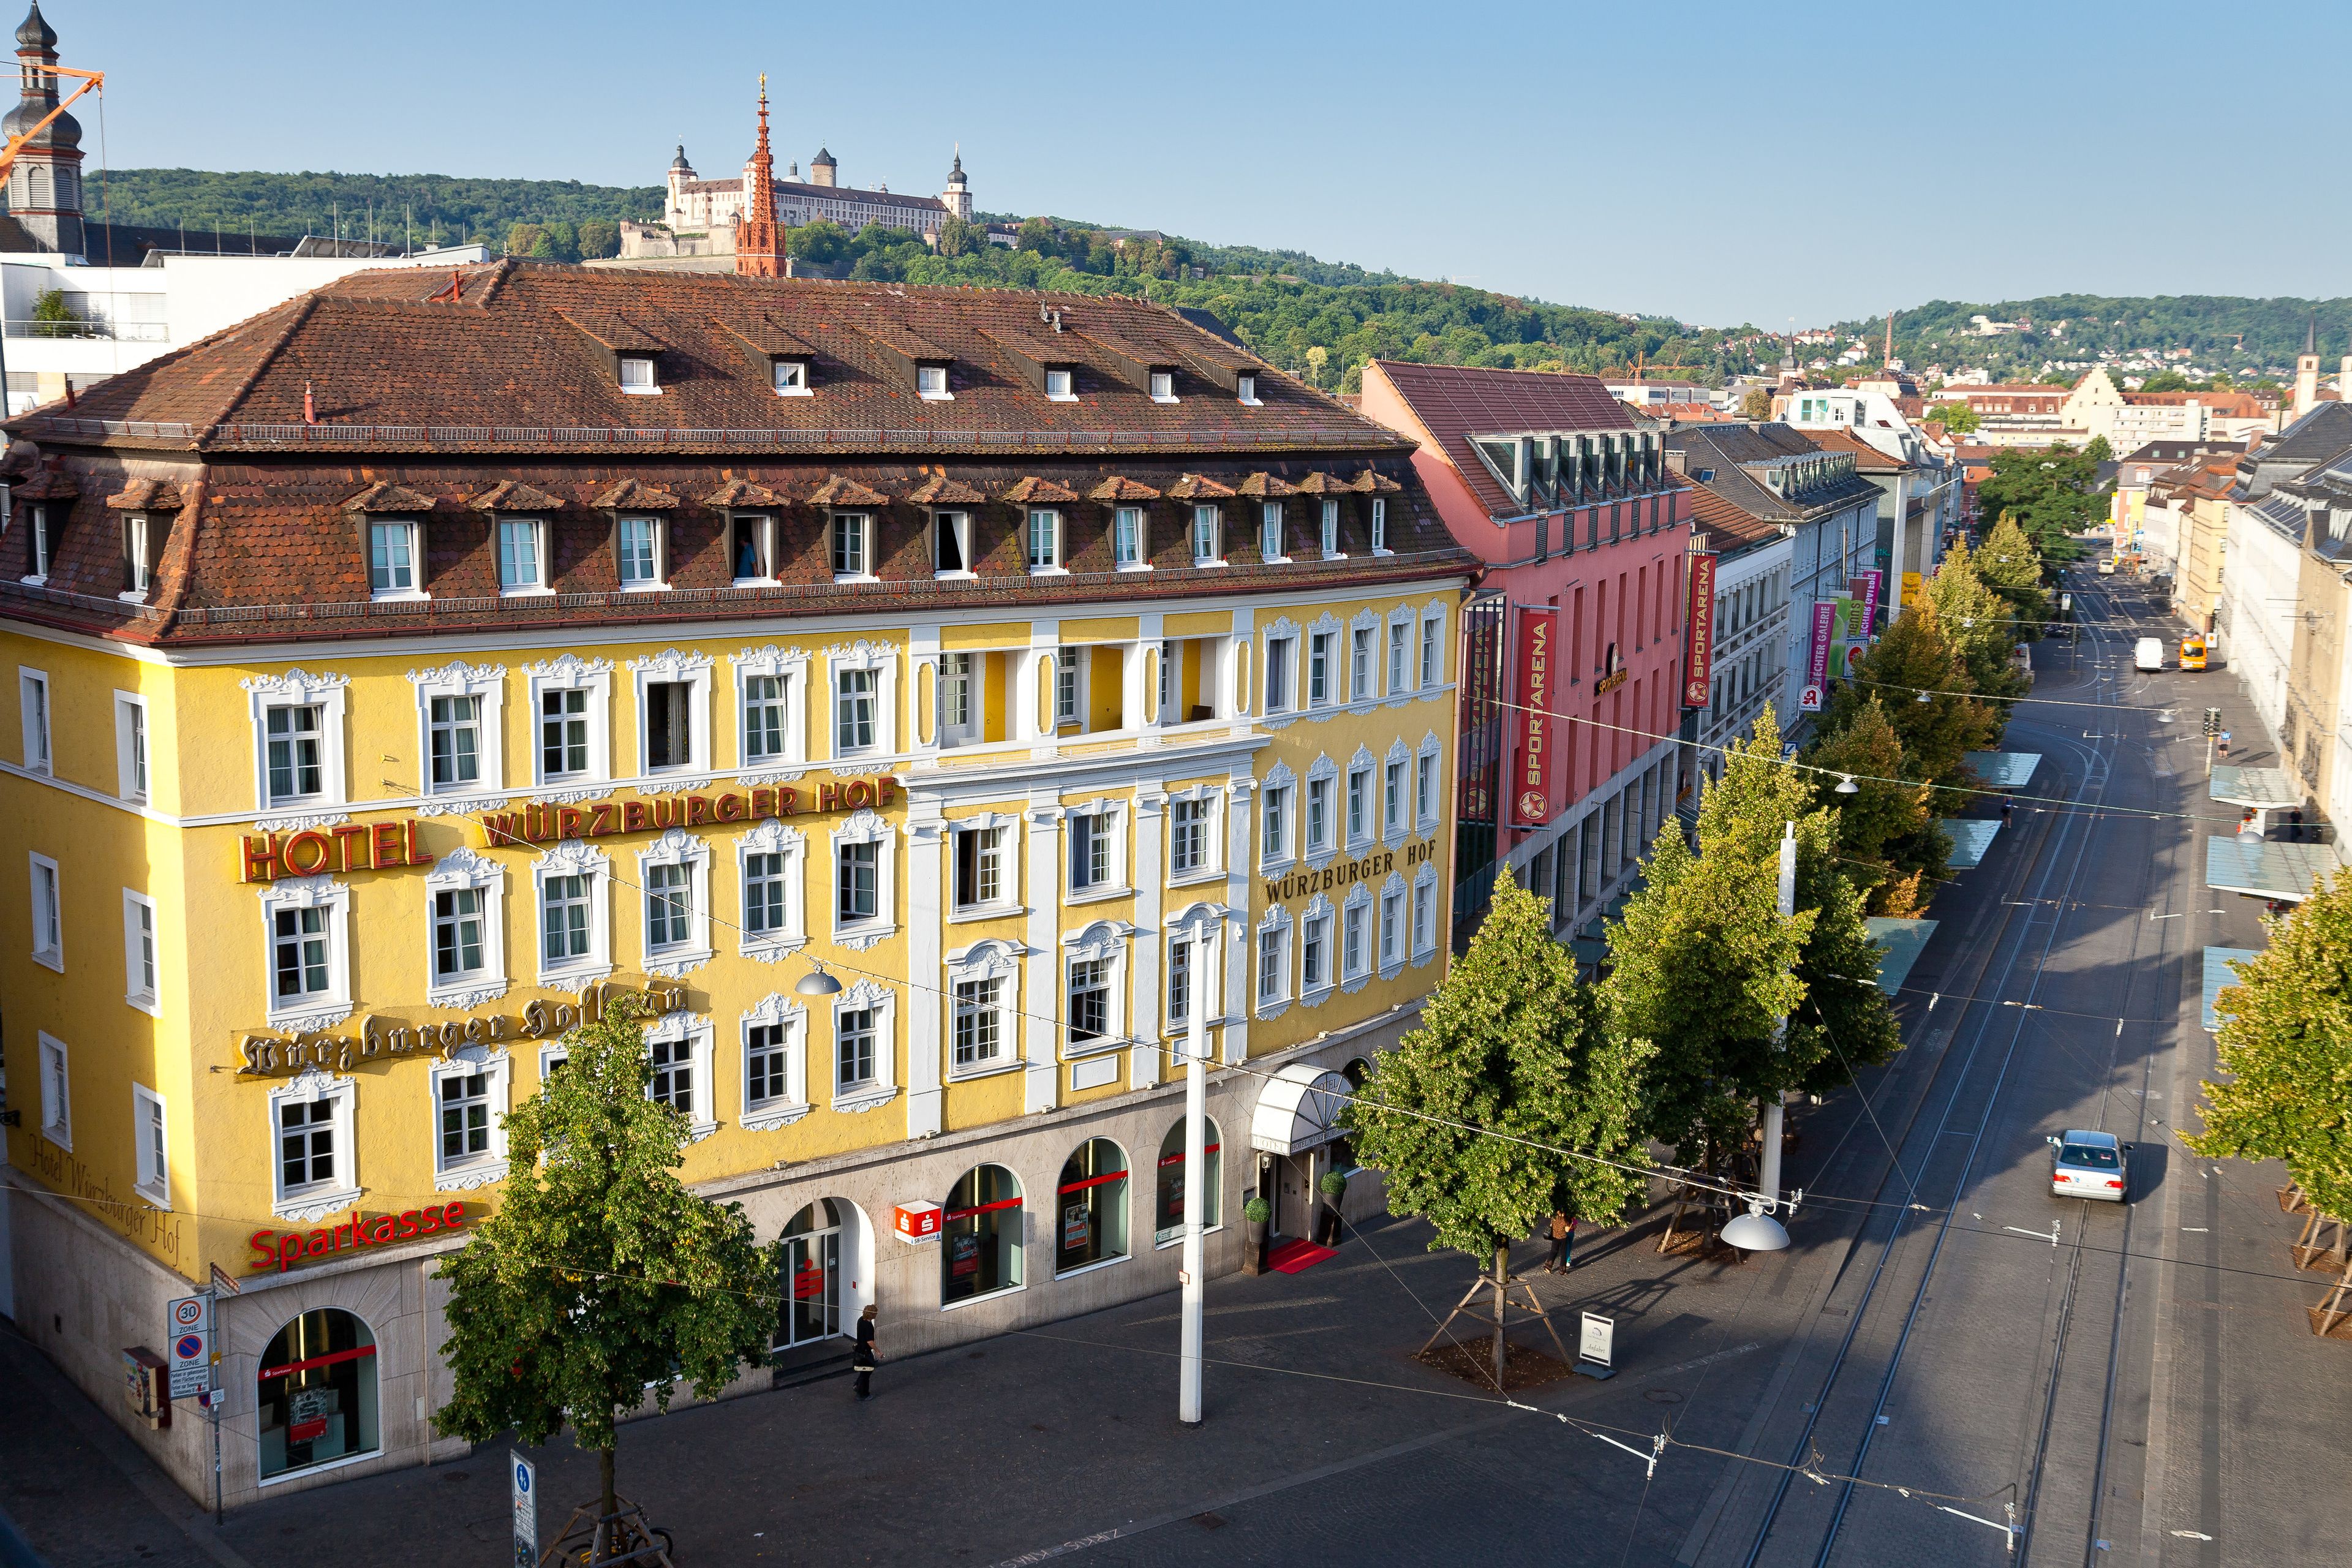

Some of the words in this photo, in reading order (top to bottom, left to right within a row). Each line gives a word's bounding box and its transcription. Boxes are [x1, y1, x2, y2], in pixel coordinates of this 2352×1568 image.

[1694, 560, 1710, 677] SPORTARENA
[1817, 606, 1830, 642] GALERIE
[1813, 644, 1826, 677] ECHTER
[1599, 668, 1627, 696] SPORTARENA
[1528, 622, 1547, 786] SPORTARENA
[480, 786, 796, 847] WÜRZBURGER
[816, 777, 895, 813] HOF
[238, 818, 434, 883] HOTEL
[1265, 852, 1393, 904] WÜRZBURGER
[1407, 839, 1437, 866] HOF
[236, 1014, 507, 1074] Würzburger
[1313, 1078, 1338, 1095] HOTEL
[1292, 1140, 1308, 1152] HOTEL
[29, 1133, 62, 1183] Hotel
[66, 1156, 146, 1237] Würzburger
[148, 1208, 181, 1267] Hof
[251, 1200, 464, 1273] Sparkasse
[914, 1235, 935, 1244] SB-Service
[179, 1324, 199, 1335] ZONE
[181, 1306, 197, 1319] 30
[179, 1359, 200, 1368] ZONE
[1586, 1344, 1605, 1354] Anfahrt
